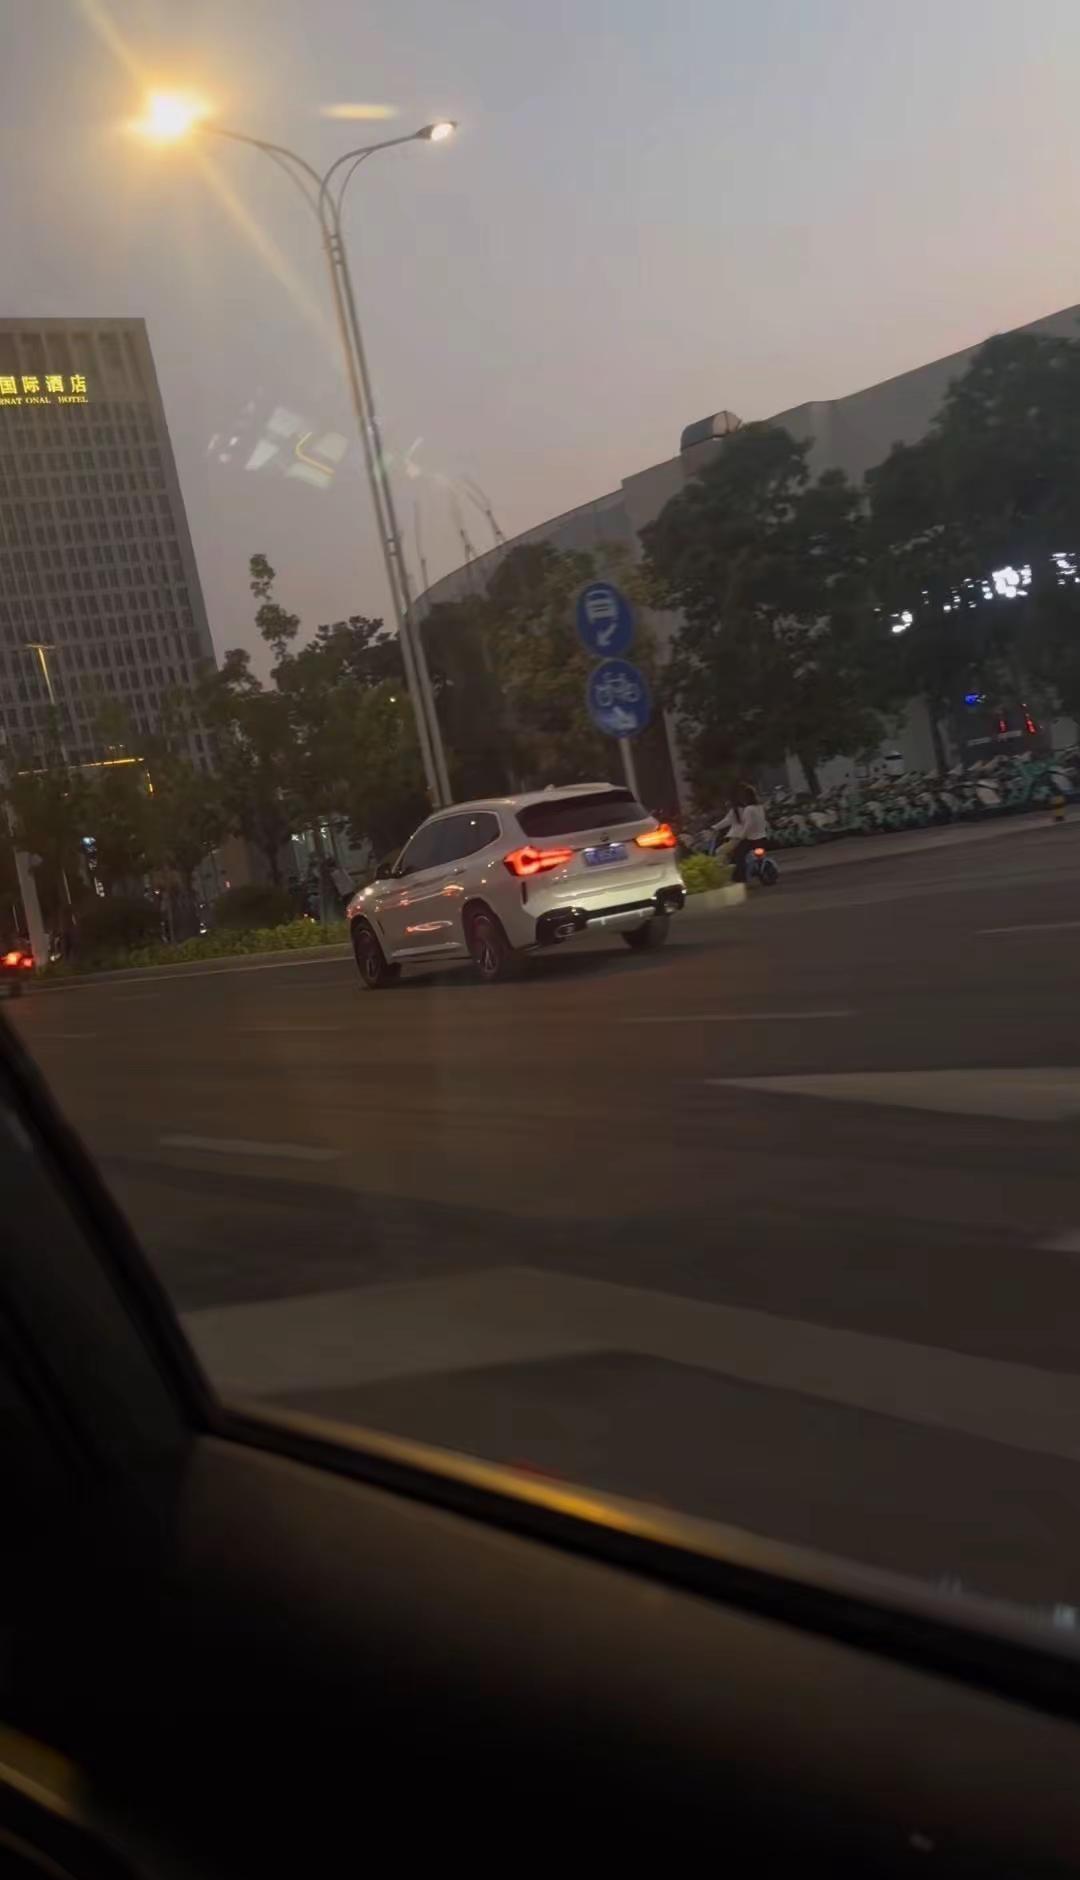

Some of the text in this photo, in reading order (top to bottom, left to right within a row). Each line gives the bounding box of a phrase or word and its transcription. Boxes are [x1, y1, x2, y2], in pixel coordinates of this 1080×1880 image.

[0, 374, 87, 394] 国际酒店
[0, 396, 51, 405] RNATONAL
